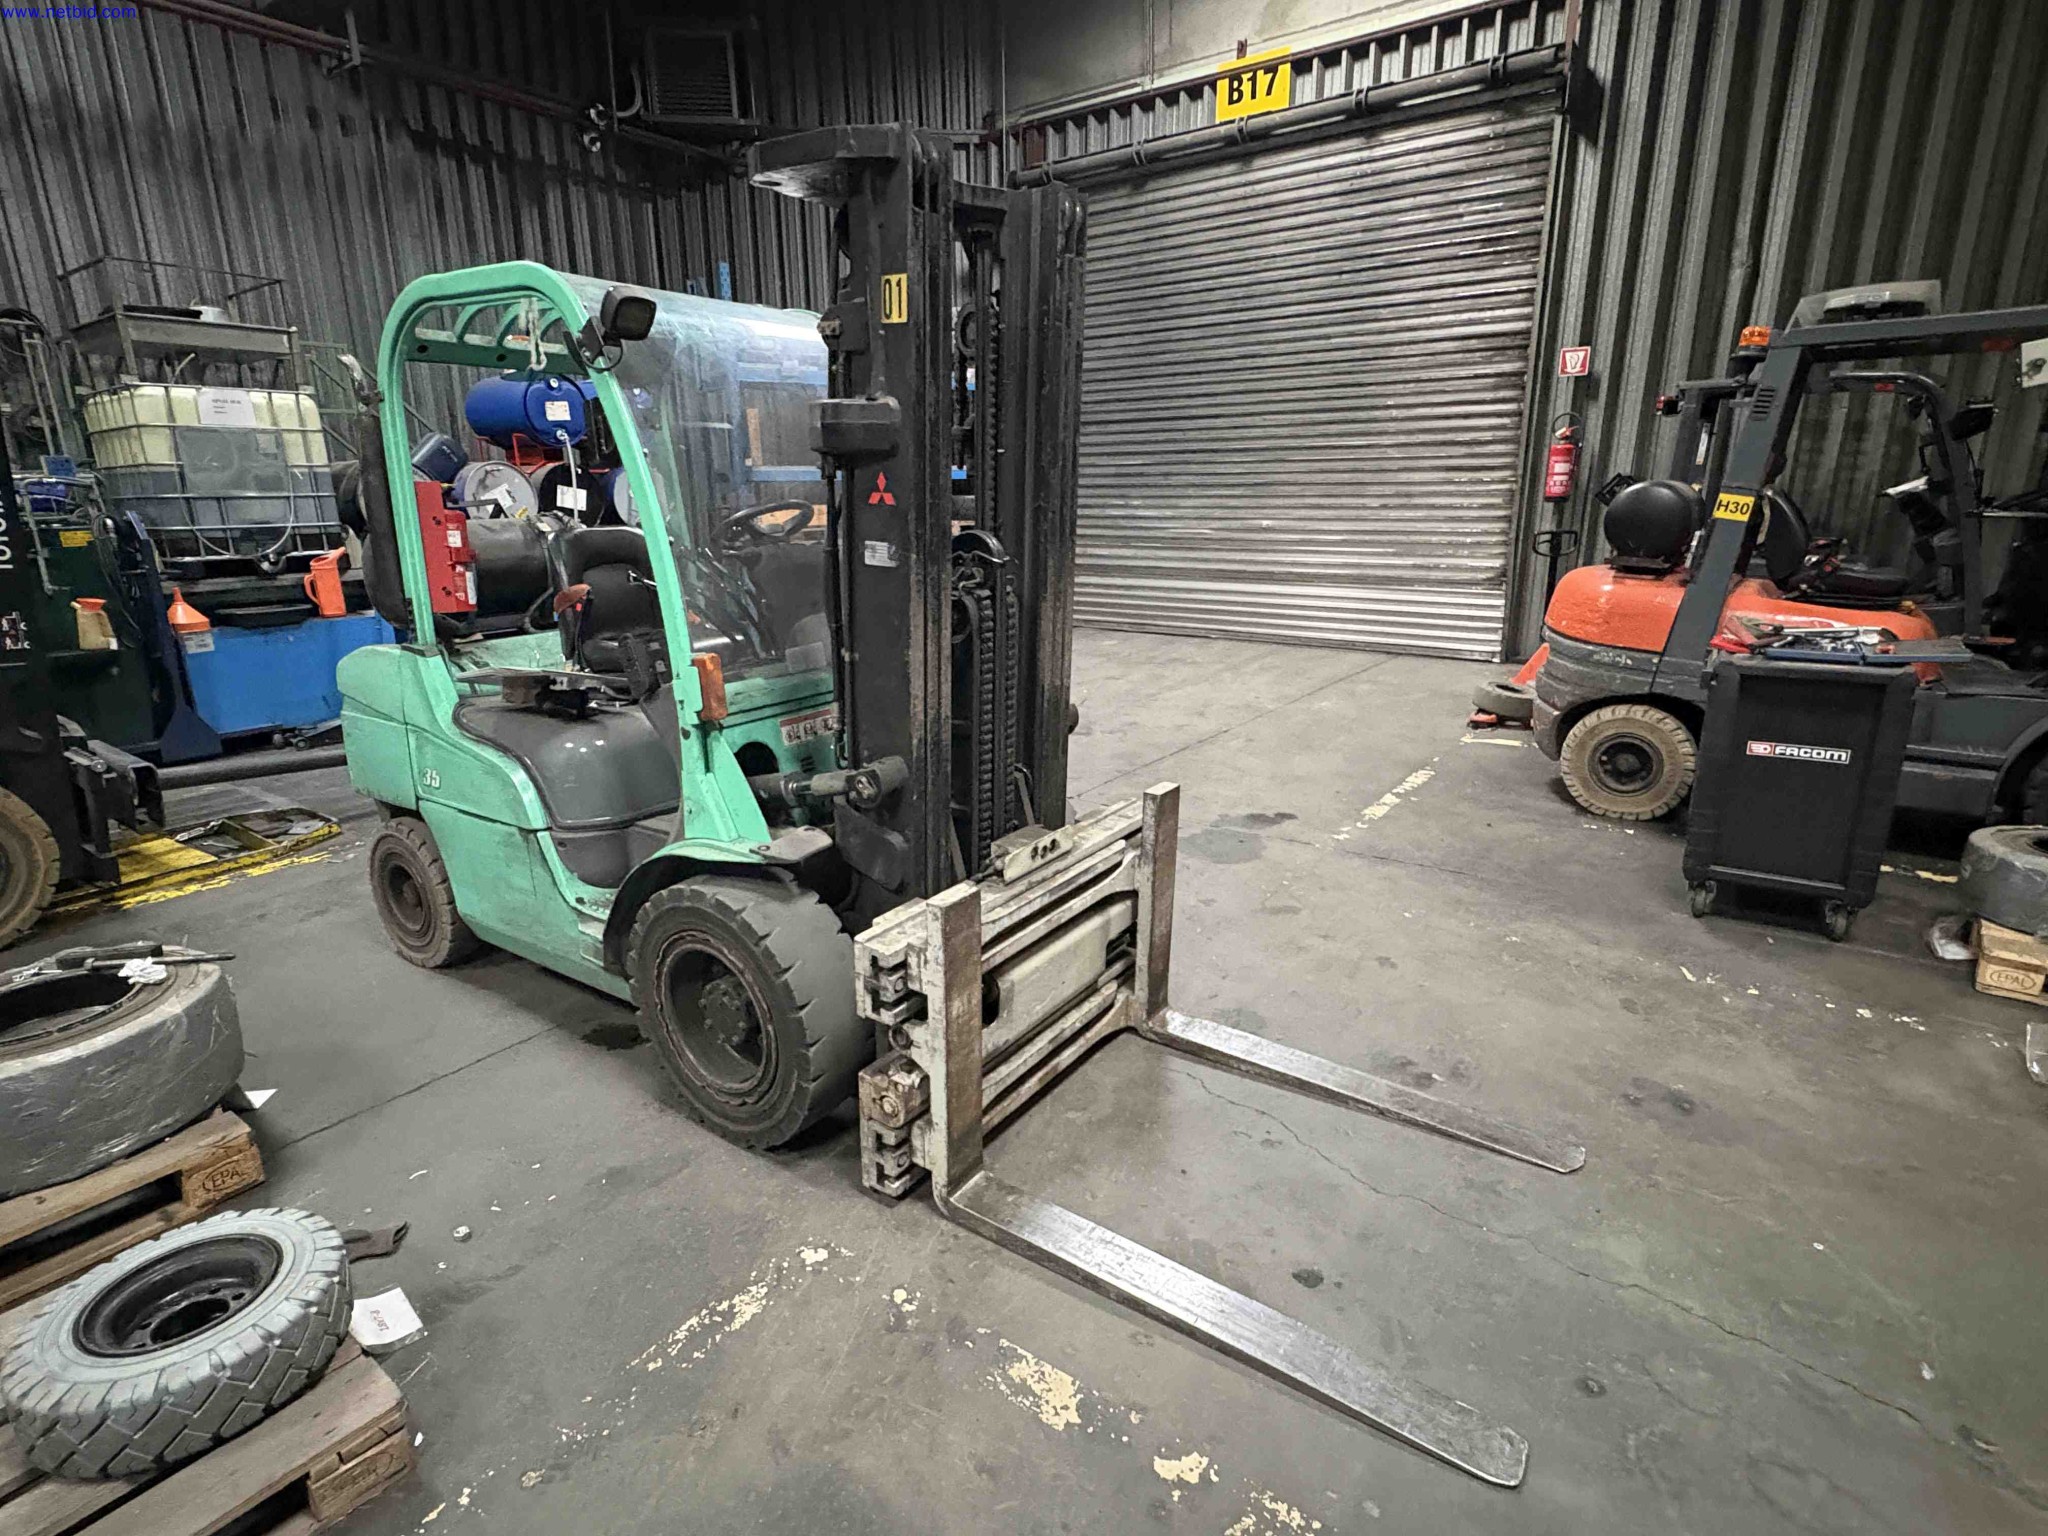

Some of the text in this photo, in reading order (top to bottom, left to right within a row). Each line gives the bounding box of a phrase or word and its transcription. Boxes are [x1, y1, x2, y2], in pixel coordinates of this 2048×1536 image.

[1228, 64, 1278, 106] B17
[883, 277, 902, 320] 01
[1716, 499, 1750, 515] H30
[1775, 746, 1847, 761] FACOM
[423, 767, 440, 788] 35
